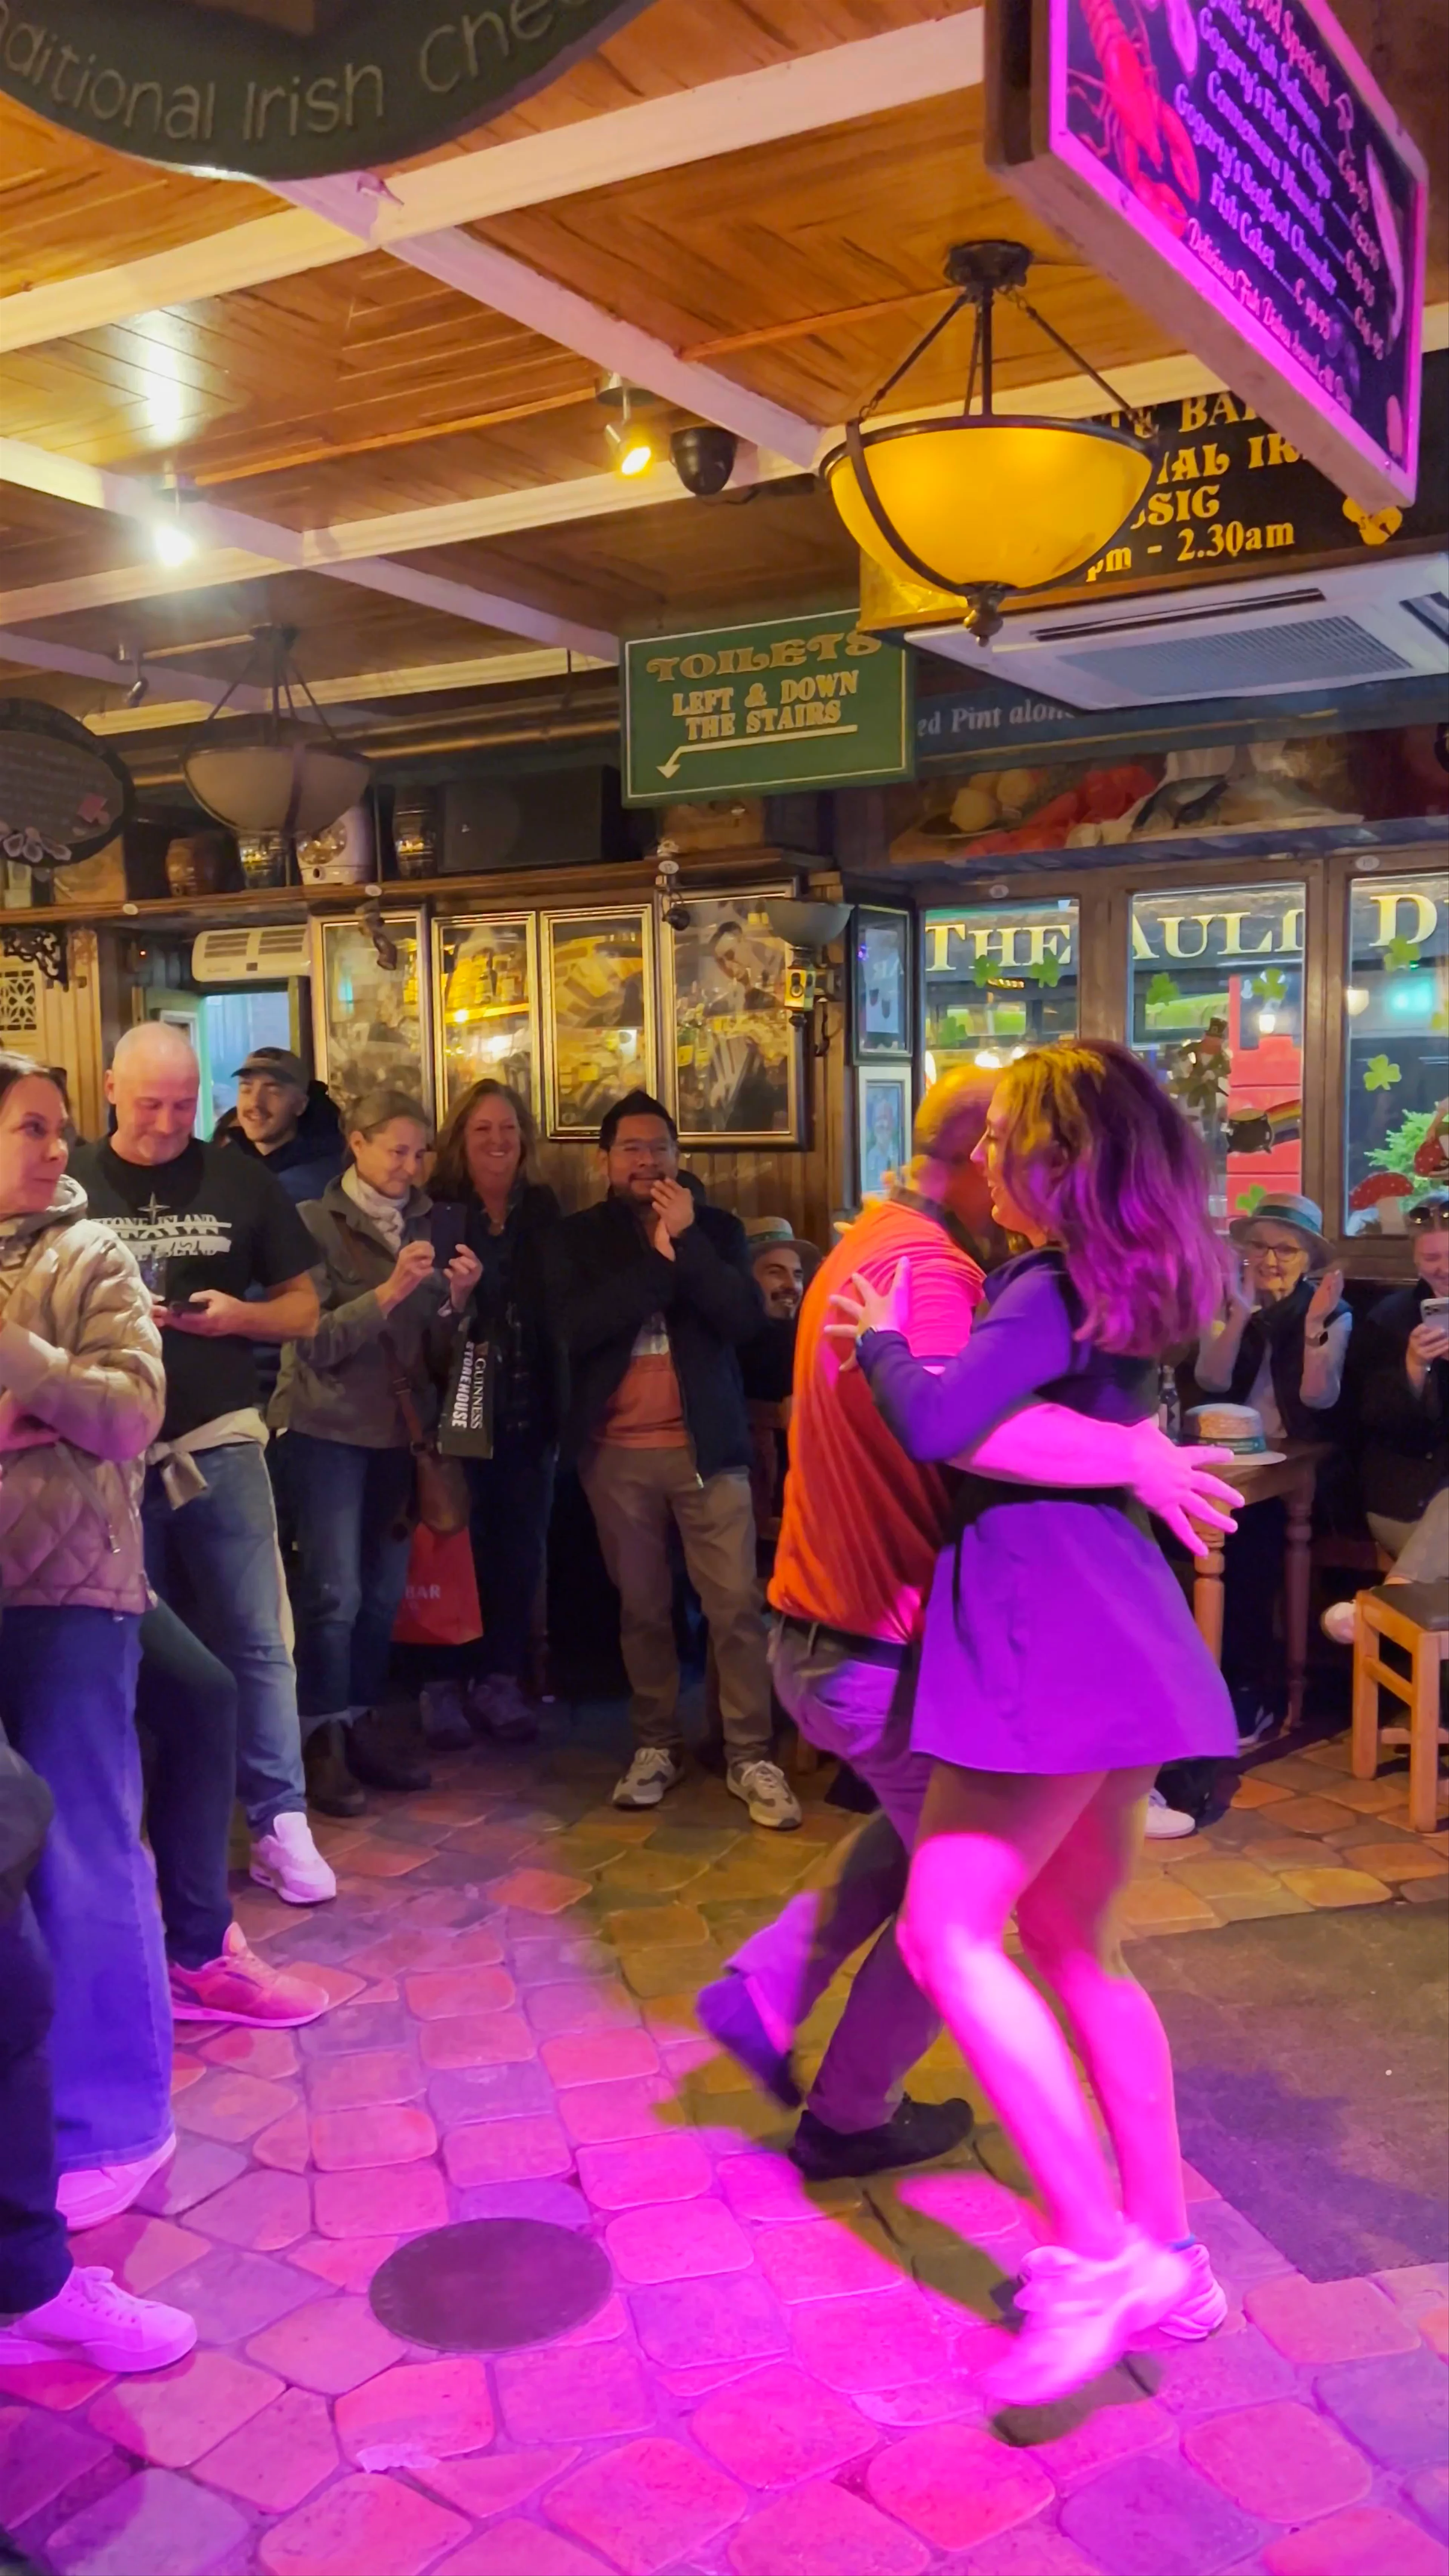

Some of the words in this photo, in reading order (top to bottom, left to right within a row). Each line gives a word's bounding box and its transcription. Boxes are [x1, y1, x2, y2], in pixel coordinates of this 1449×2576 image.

[0, 7, 215, 140] ditional
[242, 63, 383, 140] Irish
[420, 0, 554, 93] Che
[1247, 17, 1278, 80] Irish
[1282, 10, 1331, 107] Specials
[1200, 7, 1263, 109] Gogarty's
[1263, 87, 1289, 143] Fish
[1289, 125, 1300, 158] &
[1302, 142, 1331, 199] Chips
[1175, 83, 1241, 183] Gogarty's
[1241, 163, 1291, 242] Seafood
[1210, 172, 1238, 229] Fish
[1240, 212, 1275, 271] Cakes
[1178, 392, 1257, 433] BA
[1248, 432, 1306, 469] IR
[1177, 521, 1295, 561] 2.30am
[646, 631, 882, 681] TOILETS
[672, 687, 734, 716] LEFT
[744, 683, 768, 708] &
[781, 670, 860, 704] DOWN
[685, 712, 735, 741] THE
[746, 700, 841, 733] STAIRS
[917, 711, 941, 737] ed
[951, 707, 1002, 733] Pint
[925, 924, 1071, 972] THE
[452, 1341, 474, 1429] STOREHOUSE
[470, 1358, 487, 1429] GUINNESS
